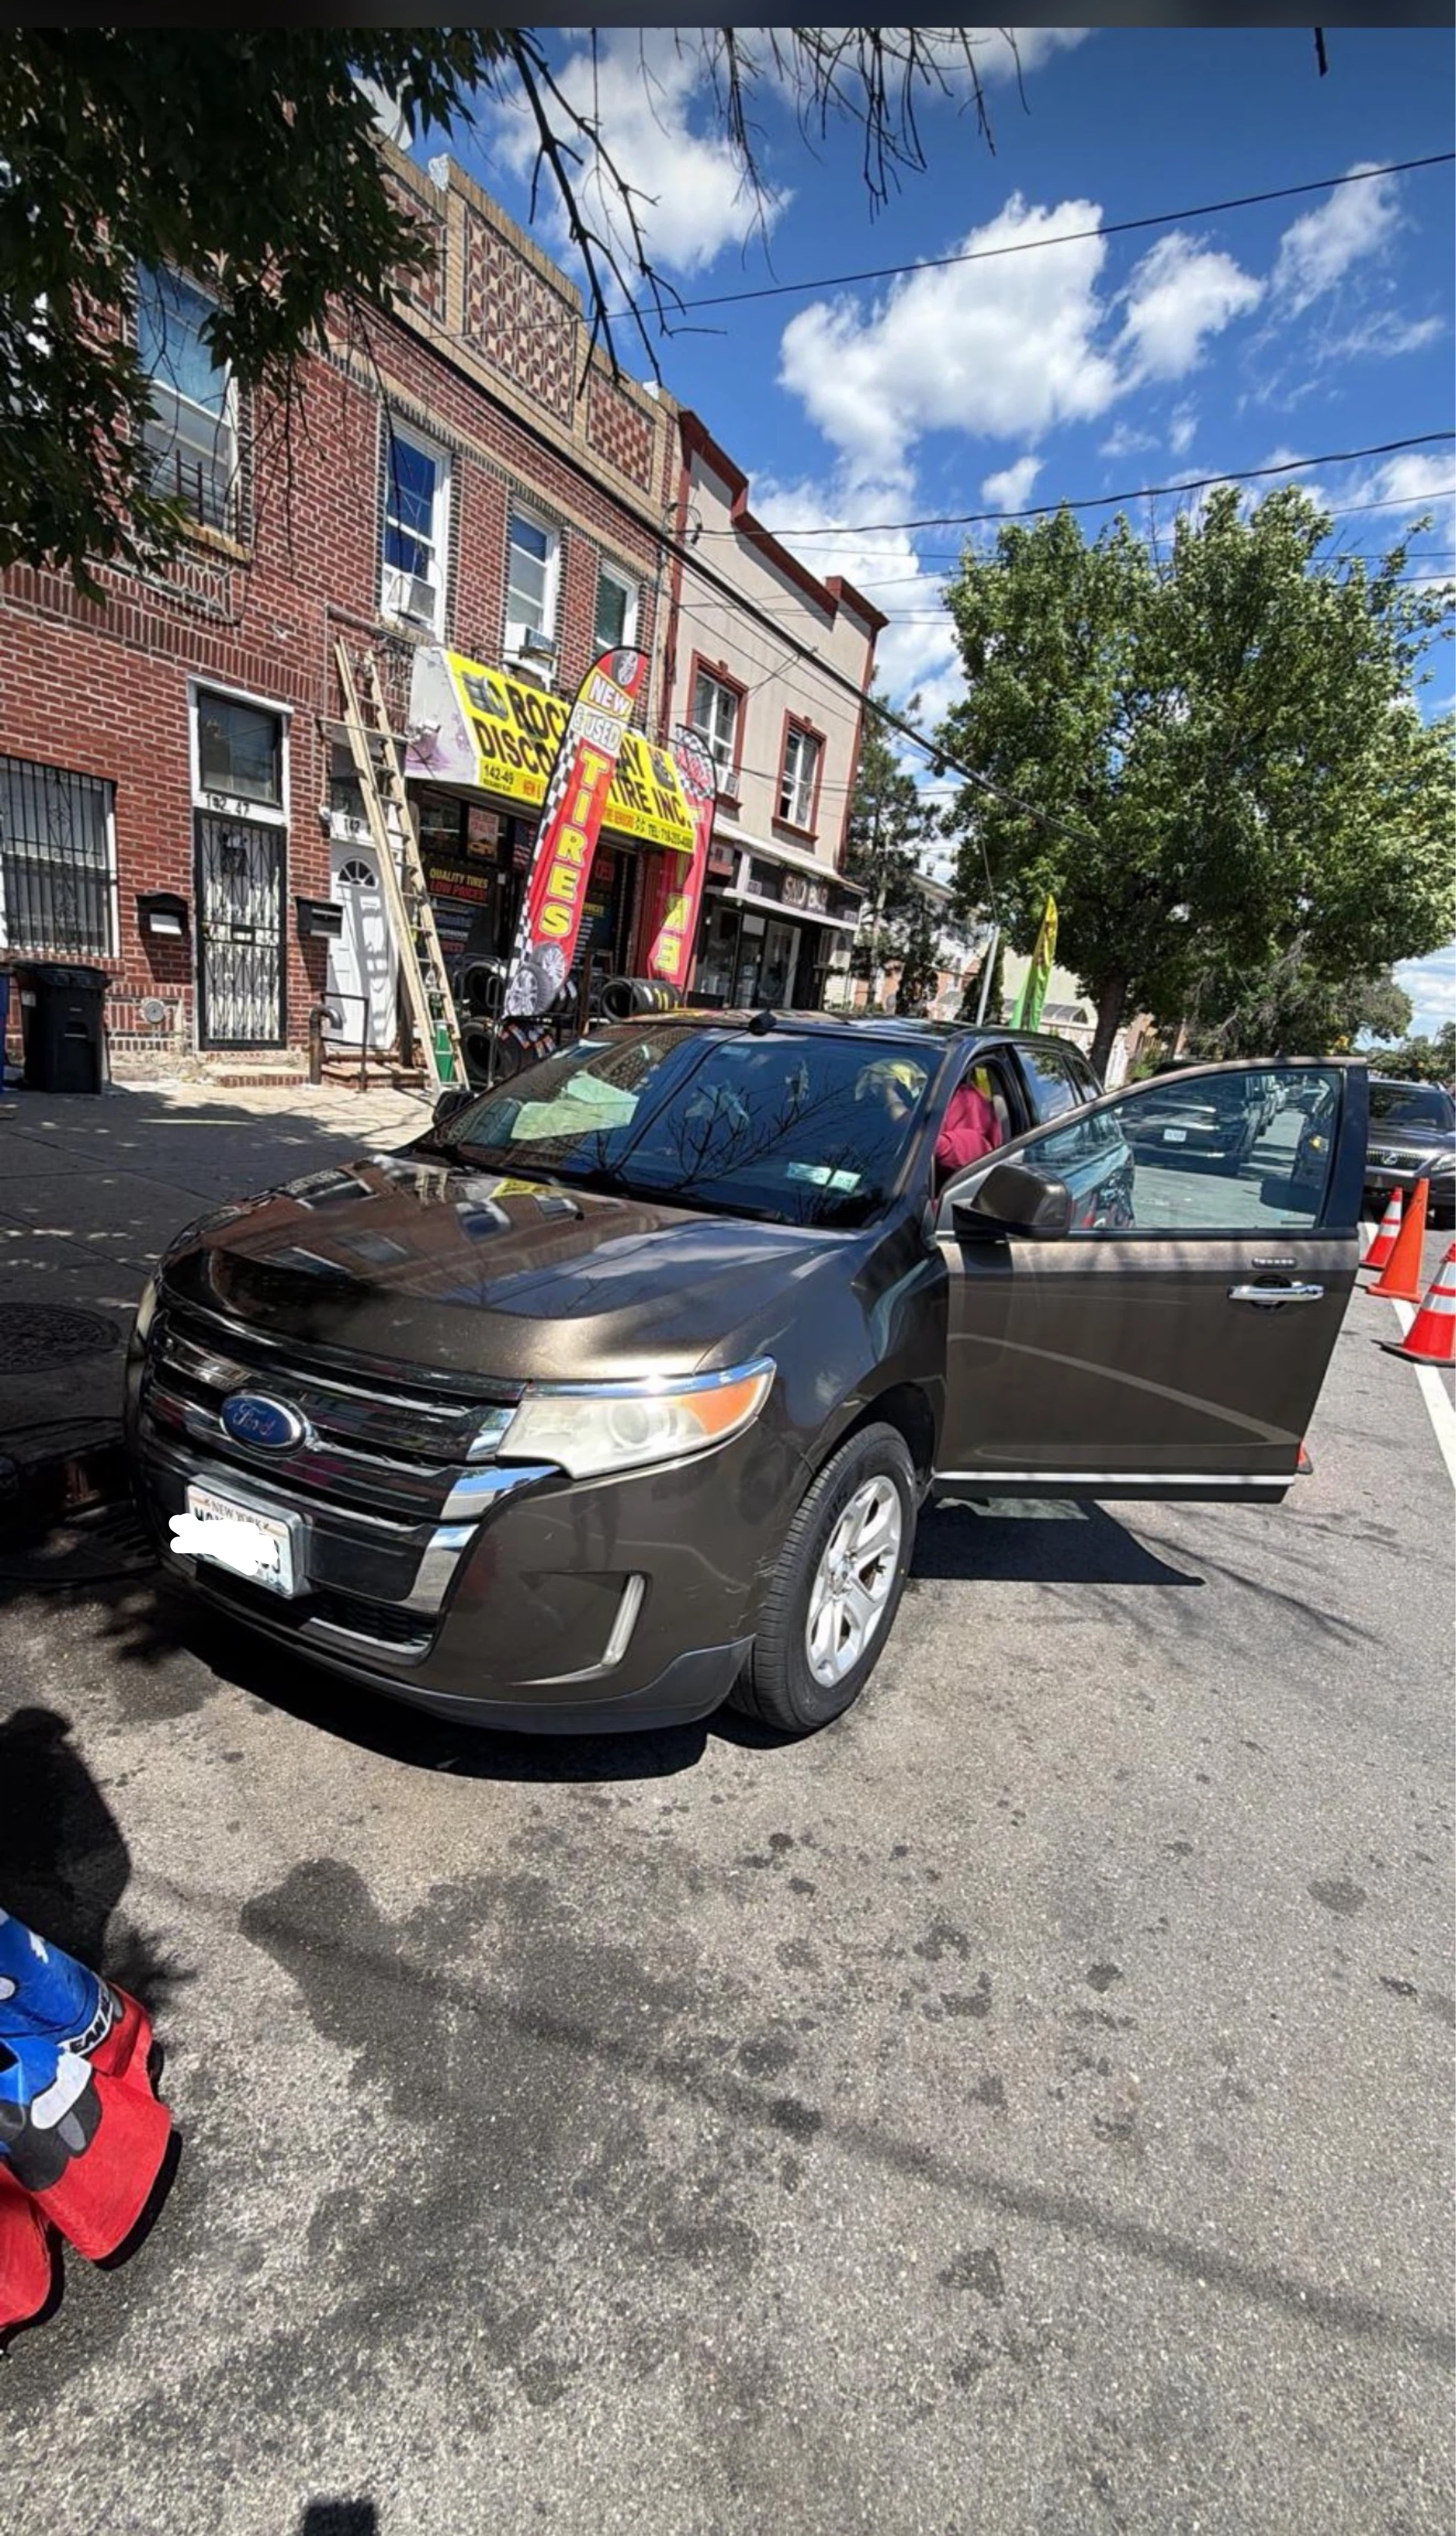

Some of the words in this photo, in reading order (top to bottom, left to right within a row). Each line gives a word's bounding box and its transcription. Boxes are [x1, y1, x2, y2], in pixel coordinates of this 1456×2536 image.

[589, 673, 631, 716] NEW
[585, 714, 621, 750] USED
[540, 747, 610, 936] TIRES
[430, 868, 465, 883] QUALITY
